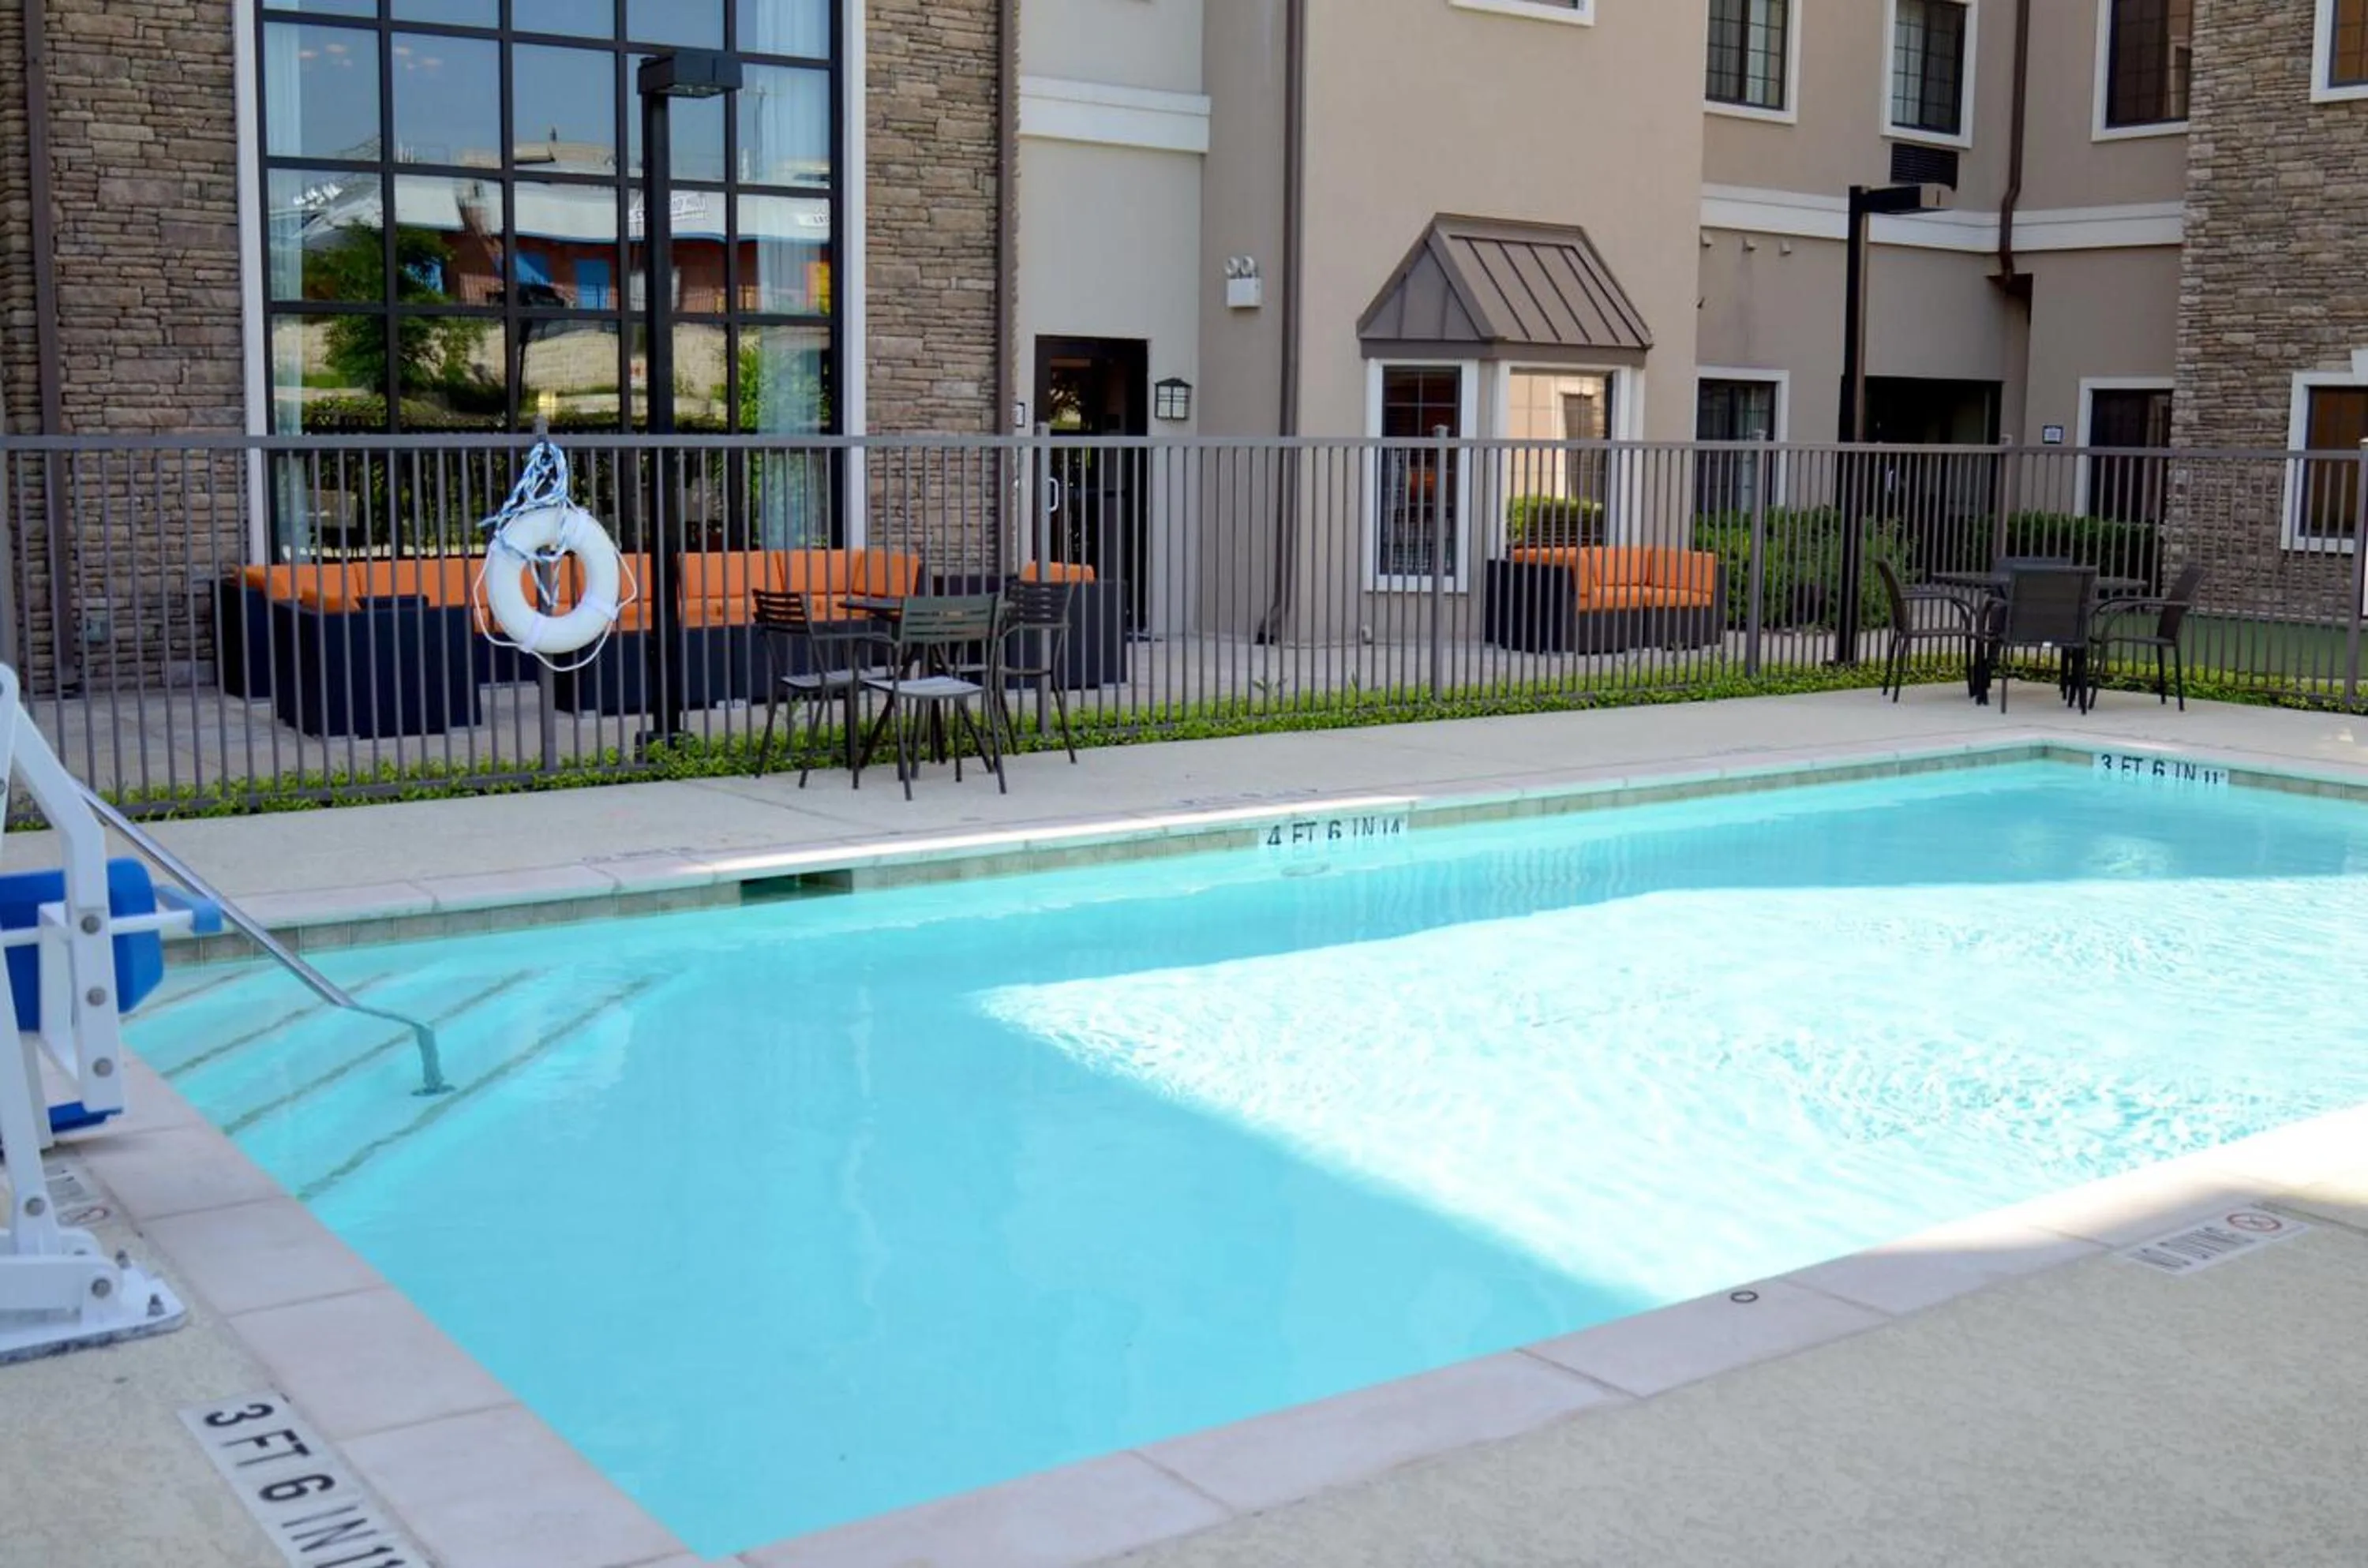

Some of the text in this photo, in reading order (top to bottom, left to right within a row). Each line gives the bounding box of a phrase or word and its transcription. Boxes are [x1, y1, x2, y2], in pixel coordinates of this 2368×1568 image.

[2101, 754, 2111, 770] 3
[2121, 755, 2144, 776] FT
[2152, 760, 2165, 777] 6
[2175, 762, 2197, 781] IN
[1266, 825, 1282, 845] 4
[1291, 821, 1317, 844] FT
[1327, 820, 1342, 840] 6
[1352, 816, 1376, 837] IN
[204, 1402, 275, 1428] 3
[219, 1428, 312, 1467] FT
[258, 1473, 336, 1503] 6
[280, 1504, 378, 1552] IN
